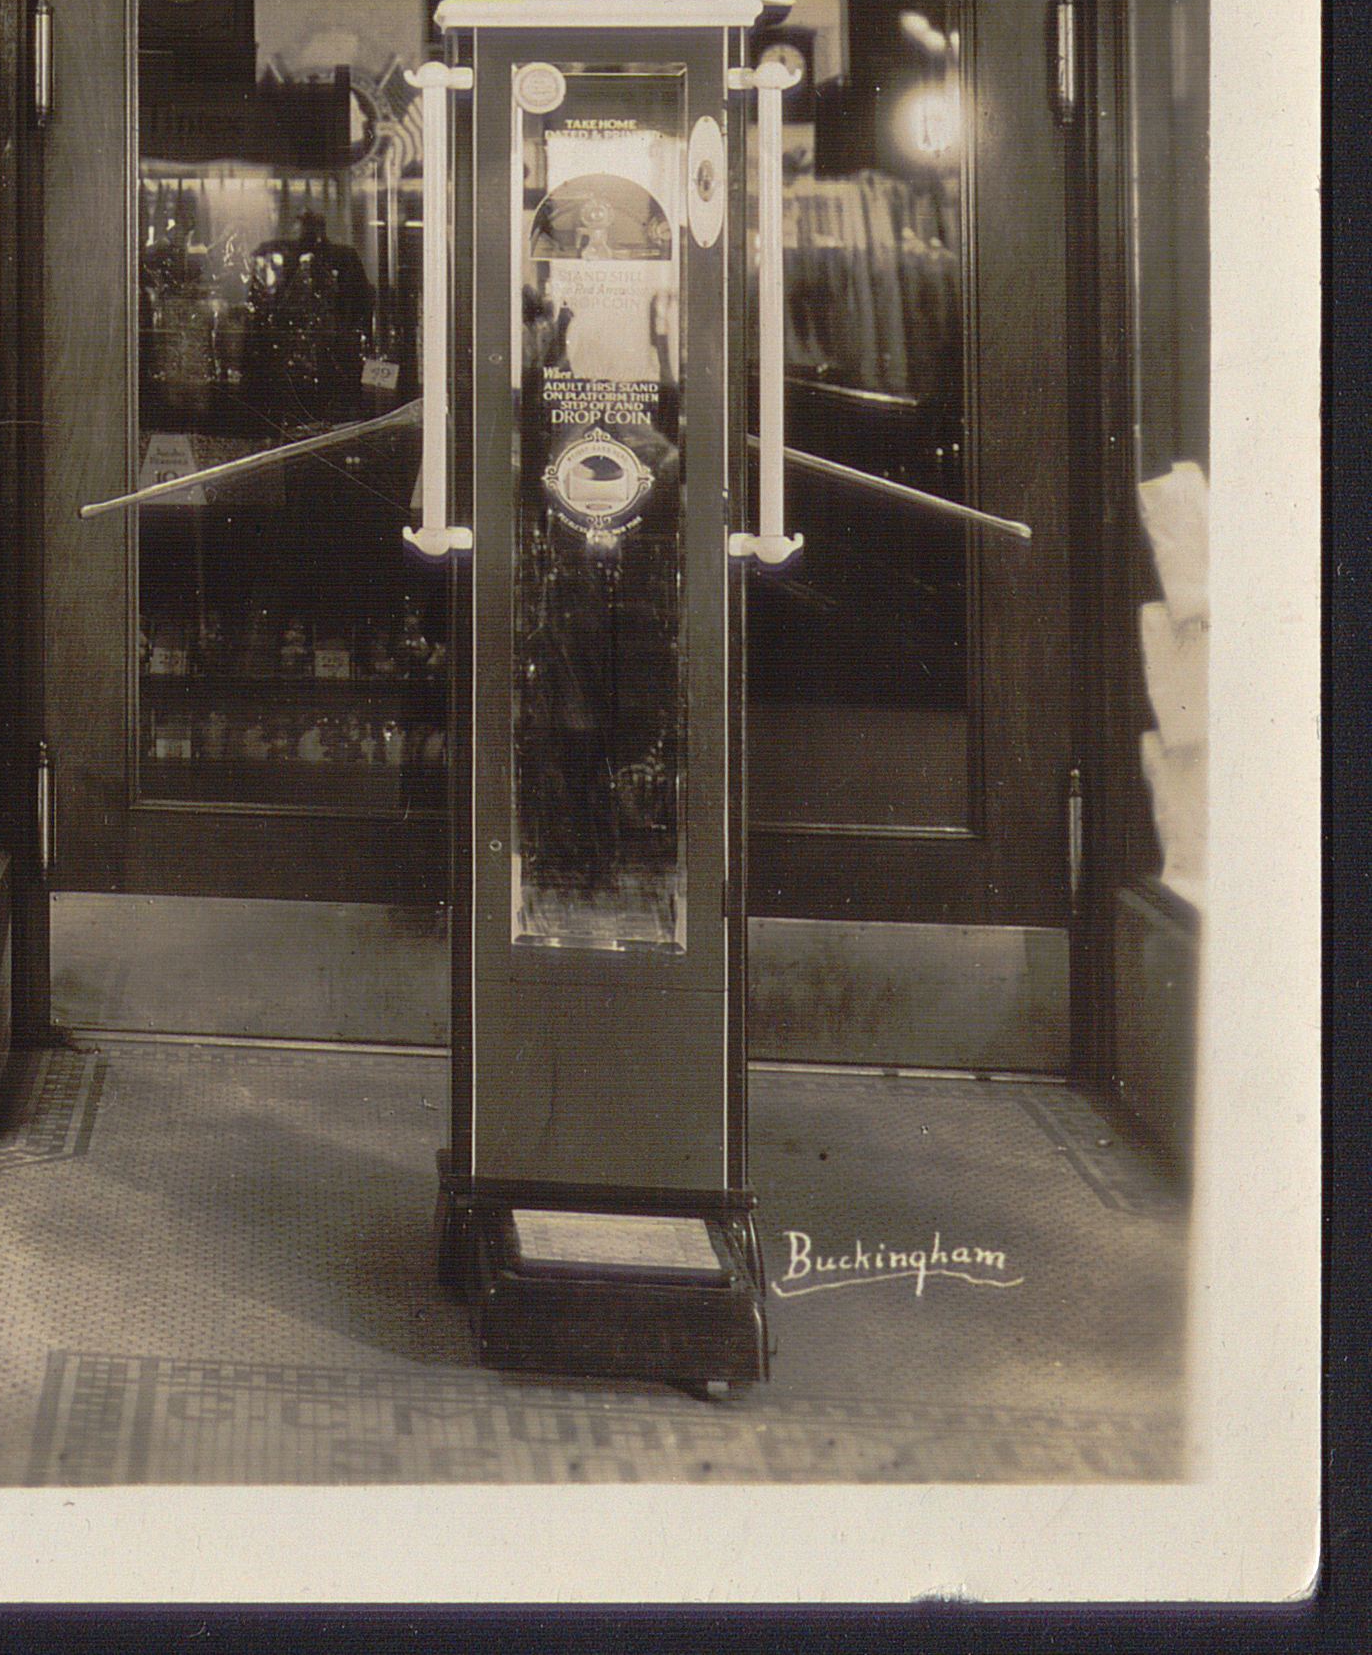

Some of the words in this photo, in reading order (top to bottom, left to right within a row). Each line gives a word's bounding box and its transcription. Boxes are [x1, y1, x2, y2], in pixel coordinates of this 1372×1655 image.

[564, 119, 597, 130] TAKE
[597, 119, 638, 130] HOME
[543, 381, 584, 392] ADULT
[585, 381, 617, 393] FIRST
[617, 382, 659, 393] STAND
[542, 391, 564, 401] ON
[565, 391, 627, 402] PLATFORM
[629, 392, 659, 403] THEN
[559, 400, 588, 411] STEP
[588, 400, 612, 411] OFF
[614, 401, 645, 412] AND
[550, 409, 602, 424] DROP
[603, 409, 653, 425] COIN
